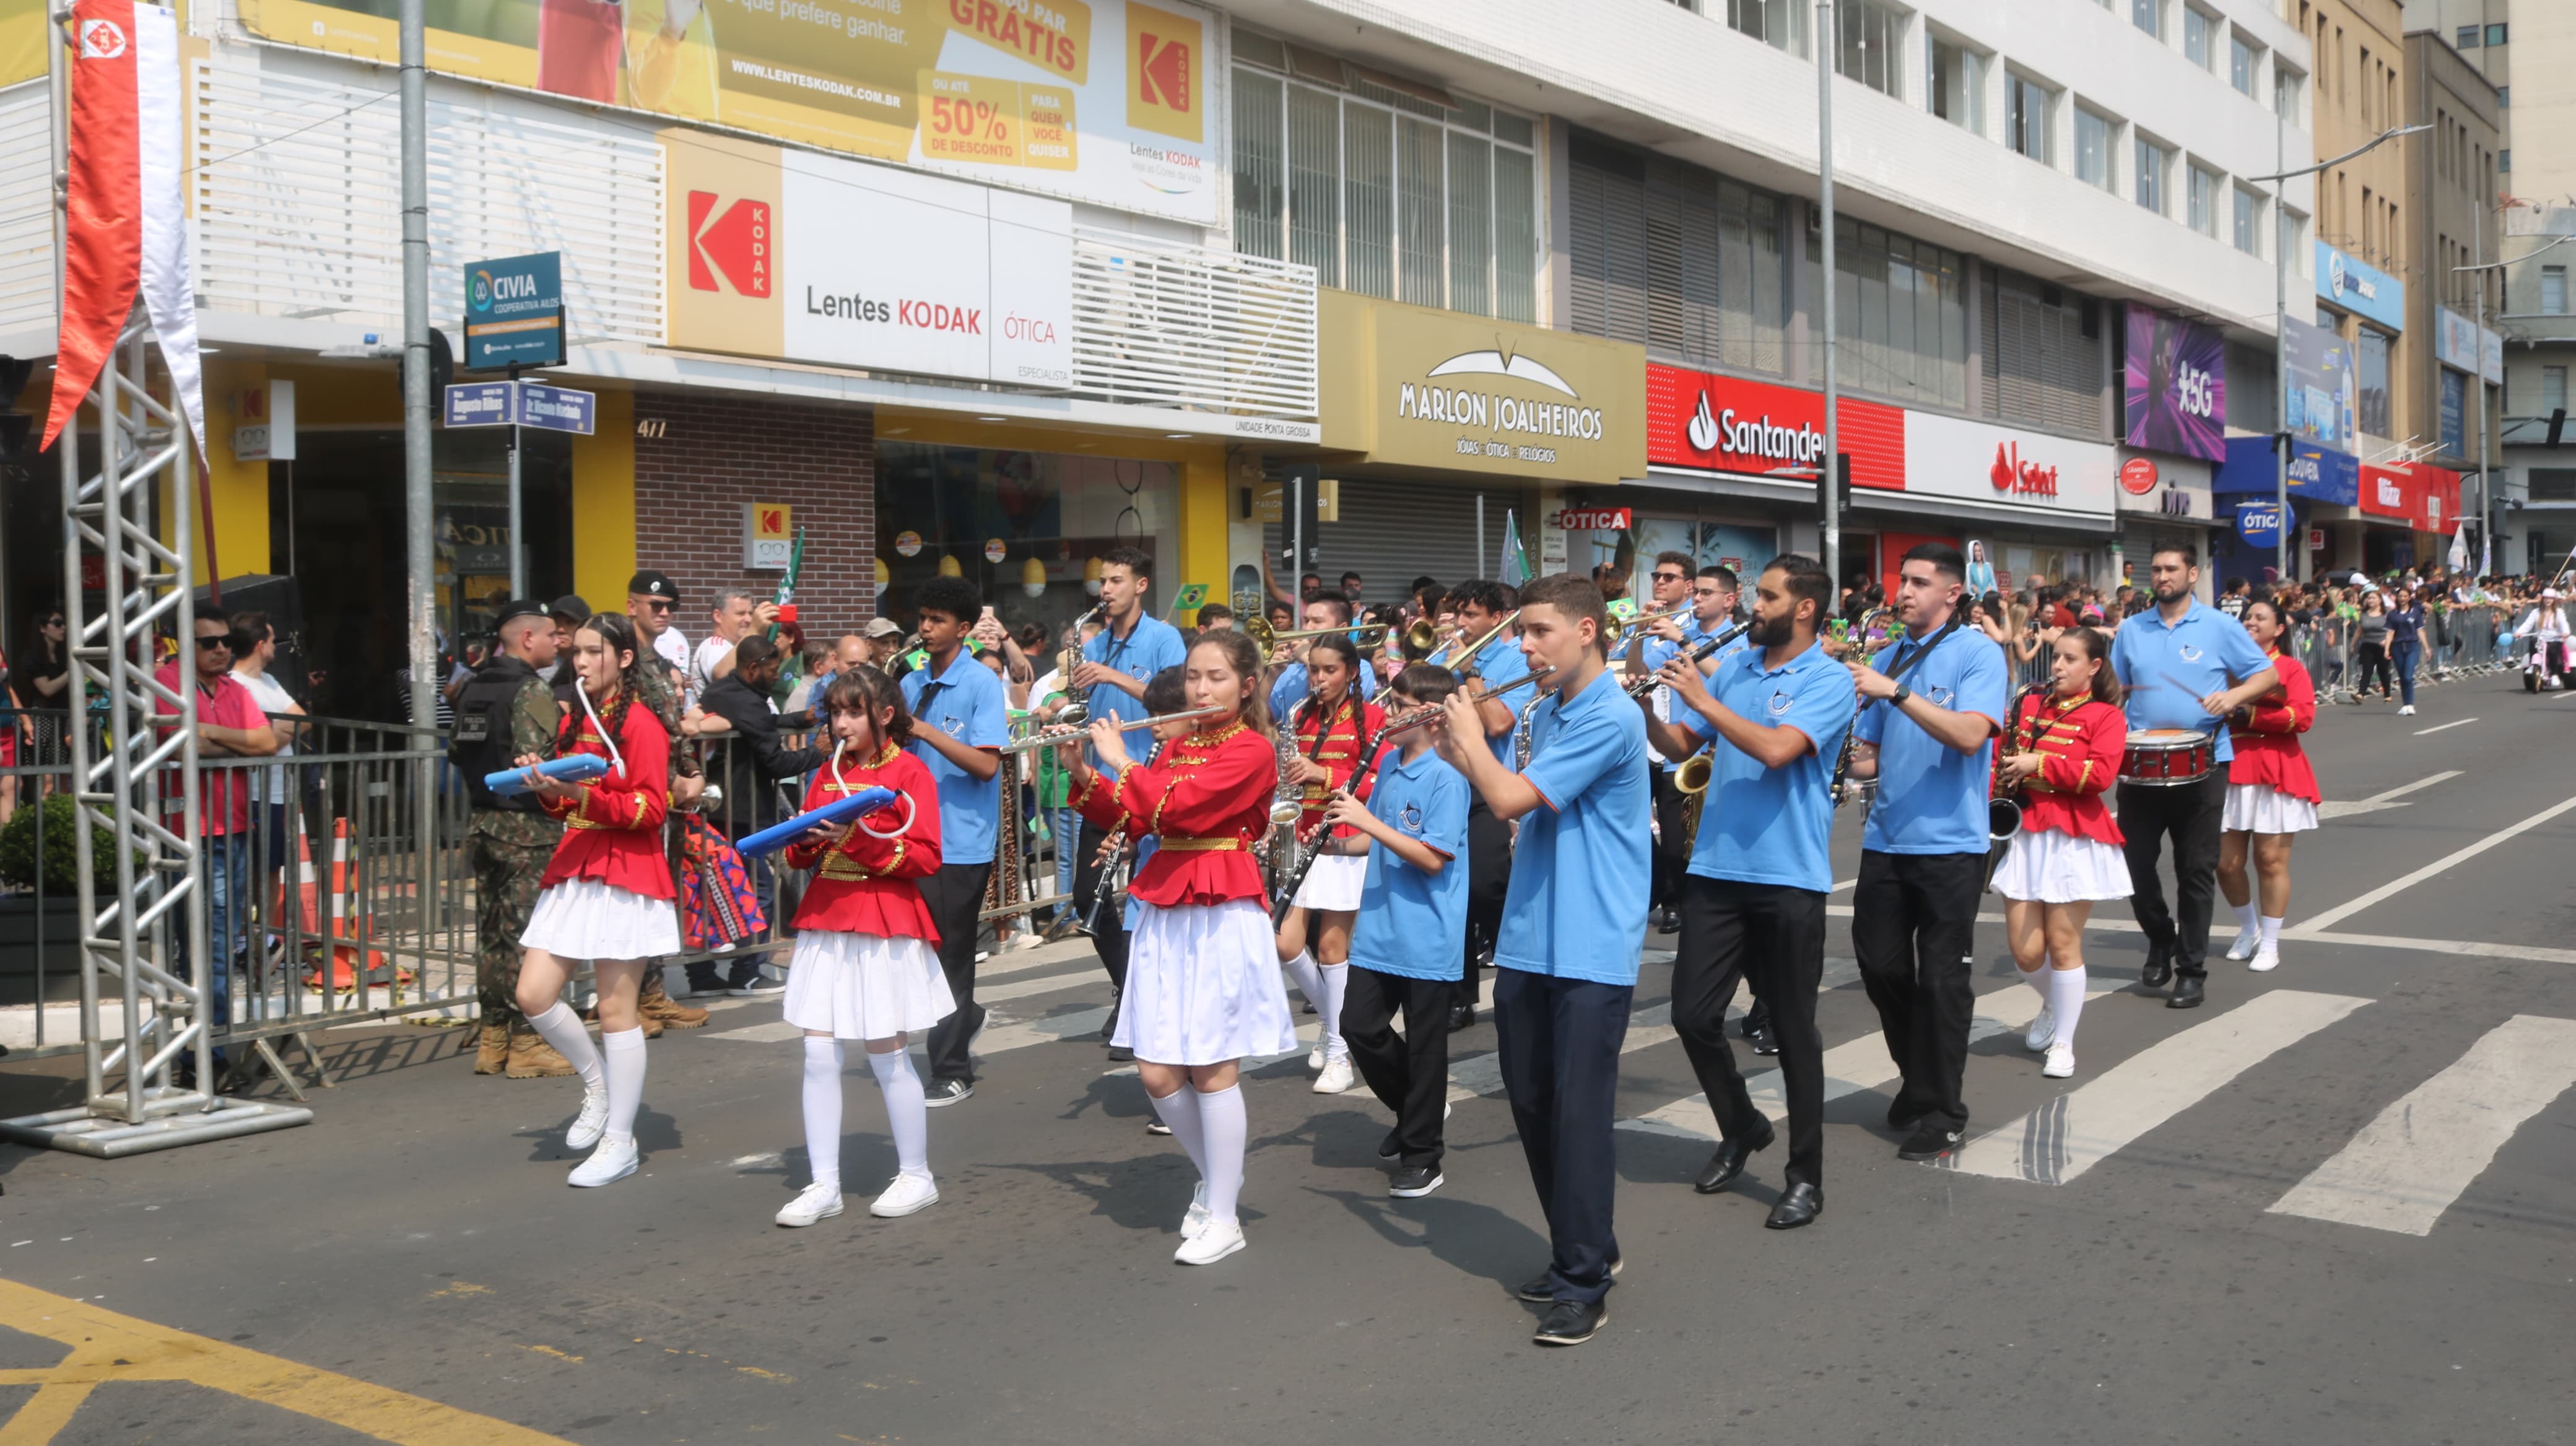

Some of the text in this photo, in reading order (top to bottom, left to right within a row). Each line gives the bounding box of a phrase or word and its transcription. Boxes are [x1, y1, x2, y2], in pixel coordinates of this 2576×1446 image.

[780, 1, 842, 29] prefere
[847, 16, 908, 45] ganhar.
[1033, 2, 1066, 33] PAR
[950, 0, 1076, 72] GRÁTIS
[732, 59, 901, 108] WWW.LENTESKODAK.COM.BR
[933, 79, 947, 90] OU
[1031, 94, 1061, 108] PARA
[932, 96, 1007, 141] 50%
[1031, 110, 1063, 124] QUEM
[931, 138, 1012, 157] DE DESCONTO
[1033, 126, 1063, 141] VOCÊ
[1028, 143, 1069, 159] QUISER
[1130, 141, 1201, 170] Lentes KODAK
[752, 207, 765, 291] KODAK
[494, 273, 537, 300] CIVIA
[494, 300, 539, 315] COOPERATIVA
[807, 285, 981, 335] Lentes KODAK
[1003, 311, 1056, 344] ÓTICA
[1018, 365, 1069, 382] ESPECIALISTA
[2190, 367, 2213, 418] 5G
[1399, 381, 1603, 442] MARLON JOALHEIROS
[1235, 421, 1263, 433] UNIDADE
[1286, 425, 1311, 438] GROSSA
[1456, 435, 1556, 463] JÓIAS ÓTICA RELÓGIOS
[1562, 510, 1625, 529] ÓTICA
